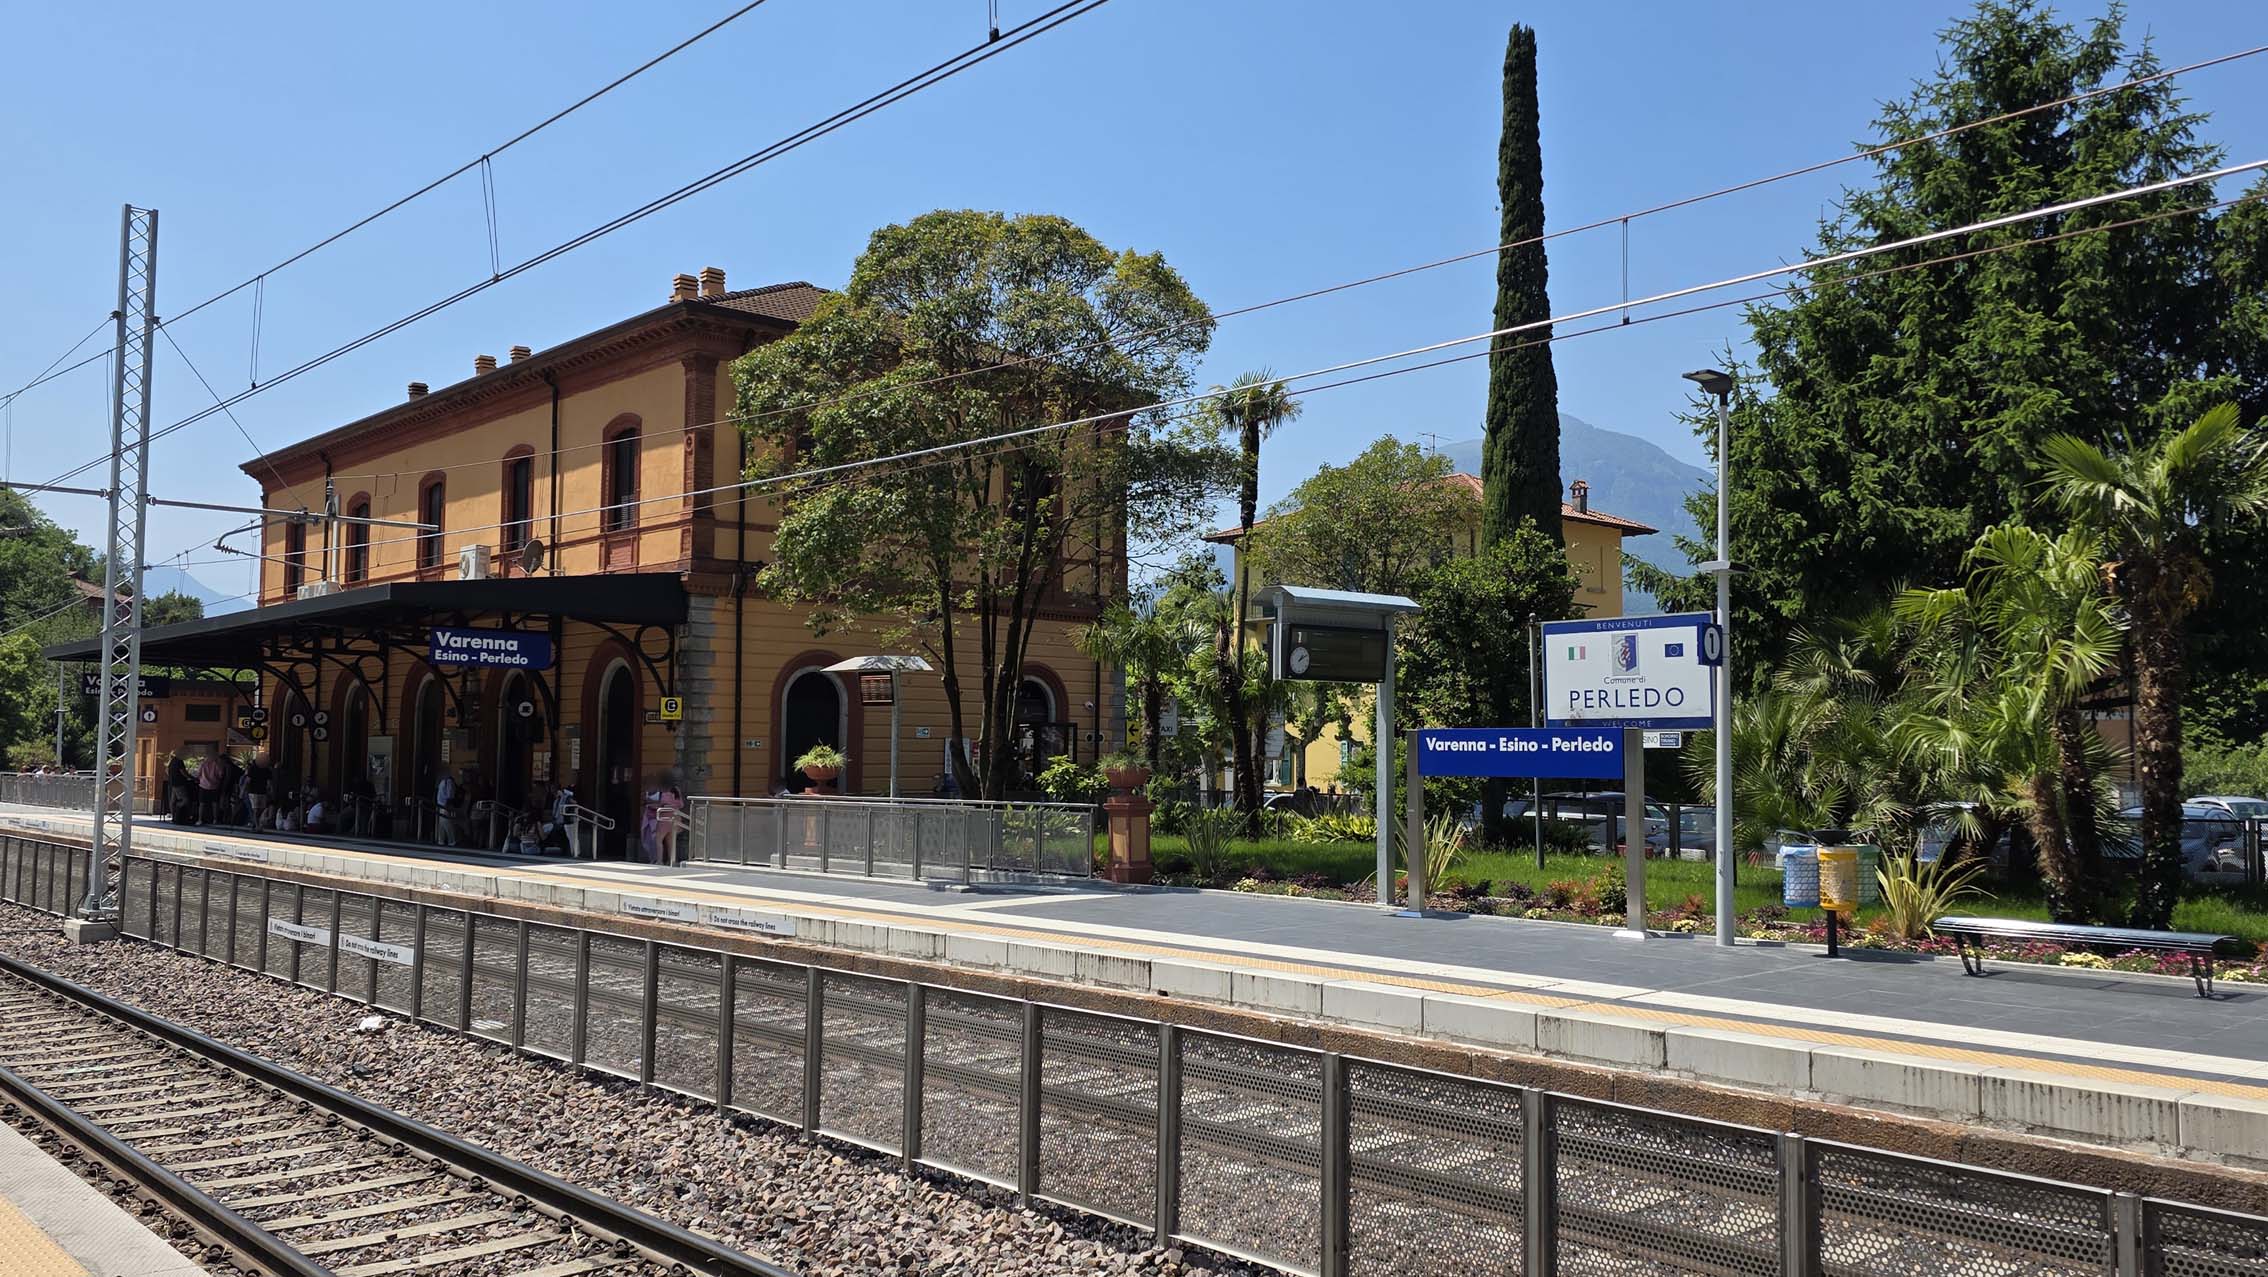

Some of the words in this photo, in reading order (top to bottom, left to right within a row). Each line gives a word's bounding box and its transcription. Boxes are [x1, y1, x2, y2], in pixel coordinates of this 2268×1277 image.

[1596, 619, 1652, 630] BENVENUTI
[436, 632, 518, 651] Varenna
[1710, 632, 1714, 654] 1
[434, 650, 468, 662] Esino
[480, 652, 528, 664] Perledo
[1604, 676, 1636, 685] Comune
[1638, 676, 1646, 684] di
[1570, 687, 1684, 709] PERLEDO
[1602, 720, 1652, 728] WELCOME
[1426, 737, 1486, 752] Varenna
[1500, 737, 1538, 752] Esino
[1552, 736, 1614, 752] Perledo
[749, 920, 764, 930] railway
[765, 922, 776, 930] lines
[387, 948, 398, 958] lines
